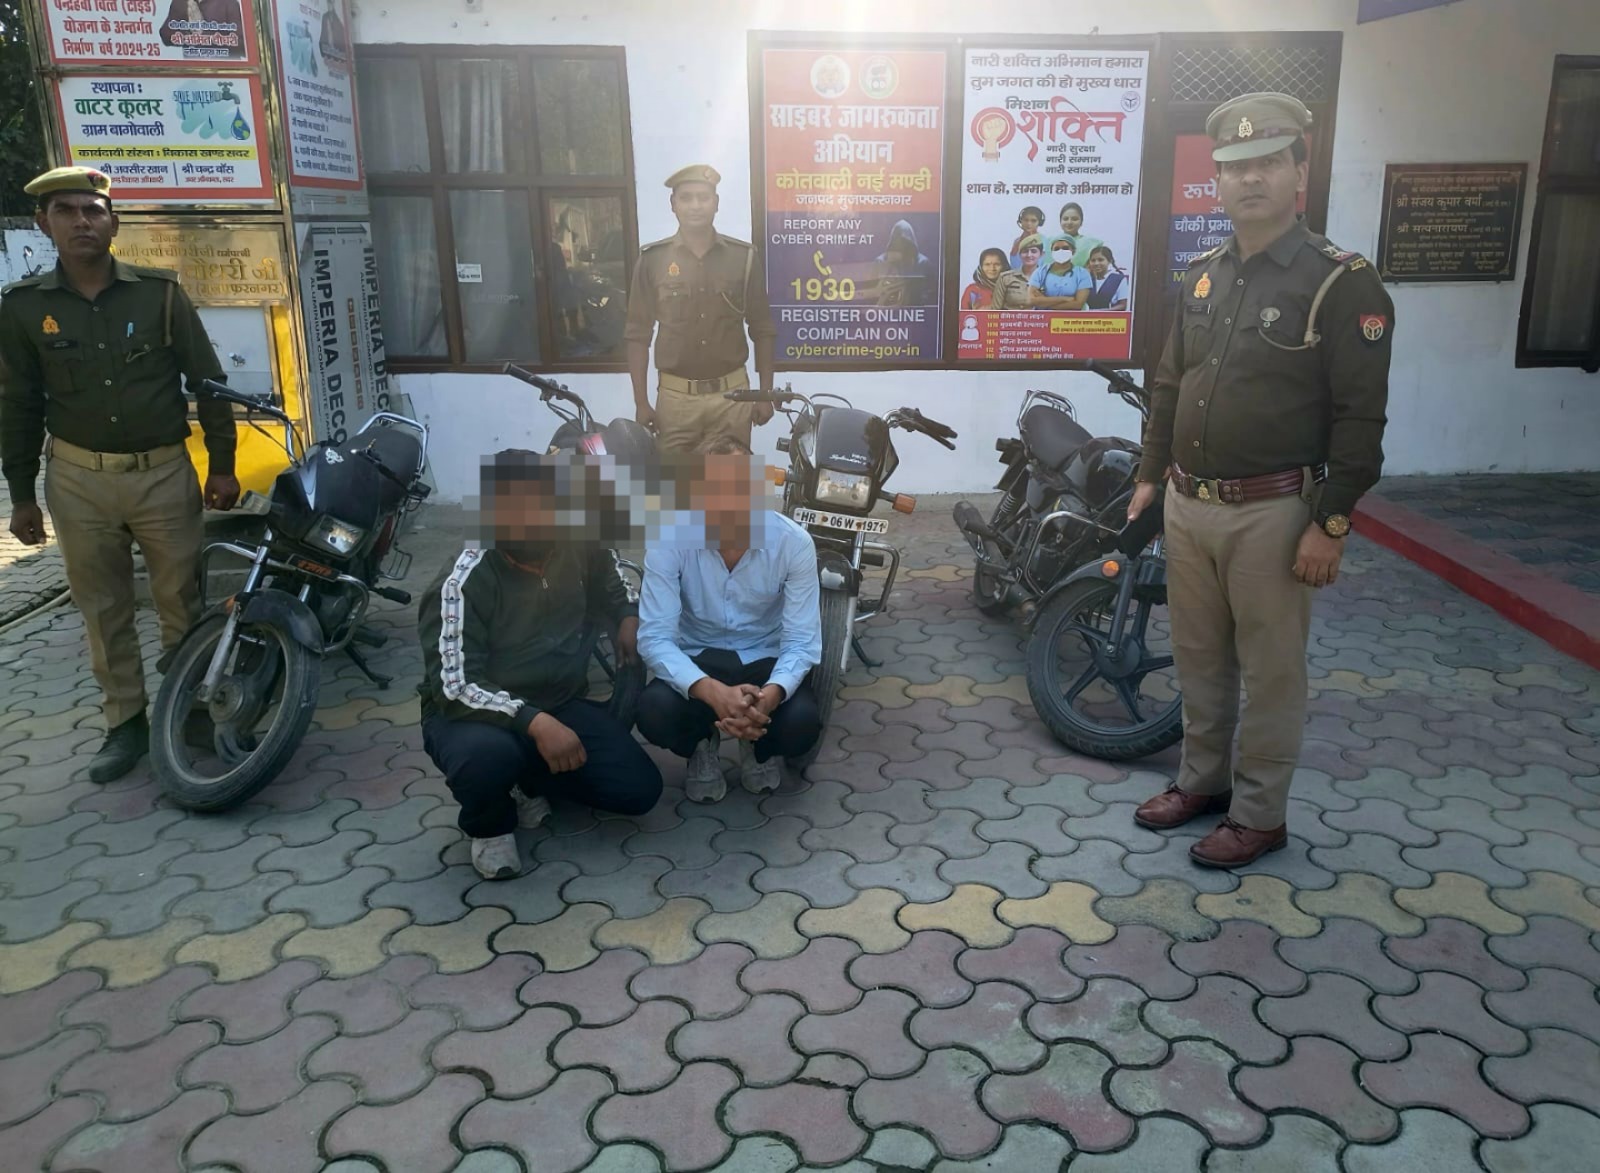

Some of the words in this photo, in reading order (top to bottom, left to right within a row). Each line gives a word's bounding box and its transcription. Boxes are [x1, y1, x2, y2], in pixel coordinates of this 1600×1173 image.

[63, 17, 98, 34] योजना
[101, 17, 111, 34] के
[114, 16, 153, 34] अन्तर्गत
[171, 32, 183, 45] श्री
[62, 38, 93, 55] निर्माण
[100, 38, 113, 55] वर्ष
[116, 42, 161, 56] 2024-25
[971, 53, 1001, 68] नारी
[1004, 53, 1041, 68] शक्ति
[1045, 54, 1102, 69] अभिमान
[1105, 56, 1144, 69] हमारा
[970, 77, 993, 91] तुम
[996, 77, 1034, 89] जगत
[1036, 75, 1056, 89] की
[1058, 75, 1074, 89] हो
[1076, 77, 1111, 92] मुख्य
[1113, 77, 1142, 89] धारा
[74, 98, 115, 115] वाटर
[117, 98, 163, 119] कूलर
[1005, 96, 1049, 110] मिशन
[769, 104, 834, 130] साइबर
[838, 104, 939, 129] जागरुकता
[82, 124, 107, 137] ग्राम
[109, 121, 164, 137] बागोवाली
[1015, 96, 1127, 162] शक्ति
[126, 148, 154, 158] संस्था
[163, 148, 198, 158] विकास
[200, 149, 225, 158] खण्ड
[226, 149, 250, 158] सदर
[813, 135, 894, 163] अभियान
[1046, 143, 1066, 153] नारी
[1069, 144, 1096, 155] सुरक्षा
[1046, 153, 1066, 163] नारी
[1068, 154, 1101, 163] सम्मान
[146, 165, 168, 174] खान
[182, 163, 194, 174] श्री
[195, 165, 214, 175] चन्द्र
[1046, 164, 1066, 174] नारी
[775, 167, 853, 191] कोतवाली
[857, 167, 885, 193] नई
[889, 167, 932, 193] मण्डी
[966, 183, 992, 194] शान
[992, 181, 1010, 195] हो,
[1012, 182, 1053, 195] सम्मान
[1055, 181, 1069, 195] हो
[1070, 182, 1119, 195] अभिमान
[1120, 180, 1133, 195] हो
[796, 194, 834, 206] जनपद
[1396, 195, 1409, 207] श्री
[1437, 198, 1462, 210] कुमार
[1465, 194, 1482, 207] वर्मा
[784, 219, 834, 230] REPORT
[836, 219, 862, 230] ANY
[1174, 215, 1205, 232] चौकी
[1397, 223, 1410, 233] श्री
[771, 233, 812, 245] CYBER
[816, 233, 856, 245] CRIME
[858, 233, 874, 245] AT
[252, 256, 277, 281] जी
[1173, 272, 1185, 281] M
[790, 278, 856, 301] 1930
[360, 271, 369, 331] ALUMINIUM
[363, 247, 385, 354] IMPERIA
[310, 276, 321, 342] ALUMINIUM
[781, 309, 861, 323] REGISTER
[864, 309, 925, 323] ONLINE
[797, 327, 882, 341] COMPLAIN
[887, 327, 909, 340] ON
[314, 249, 339, 368] IMPERIA
[327, 372, 348, 444] DECO
[786, 343, 920, 360] cybercrime-gov-in
[800, 511, 816, 524] HR
[830, 516, 843, 528] 06
[843, 518, 856, 529] W
[862, 519, 885, 533] 1971
